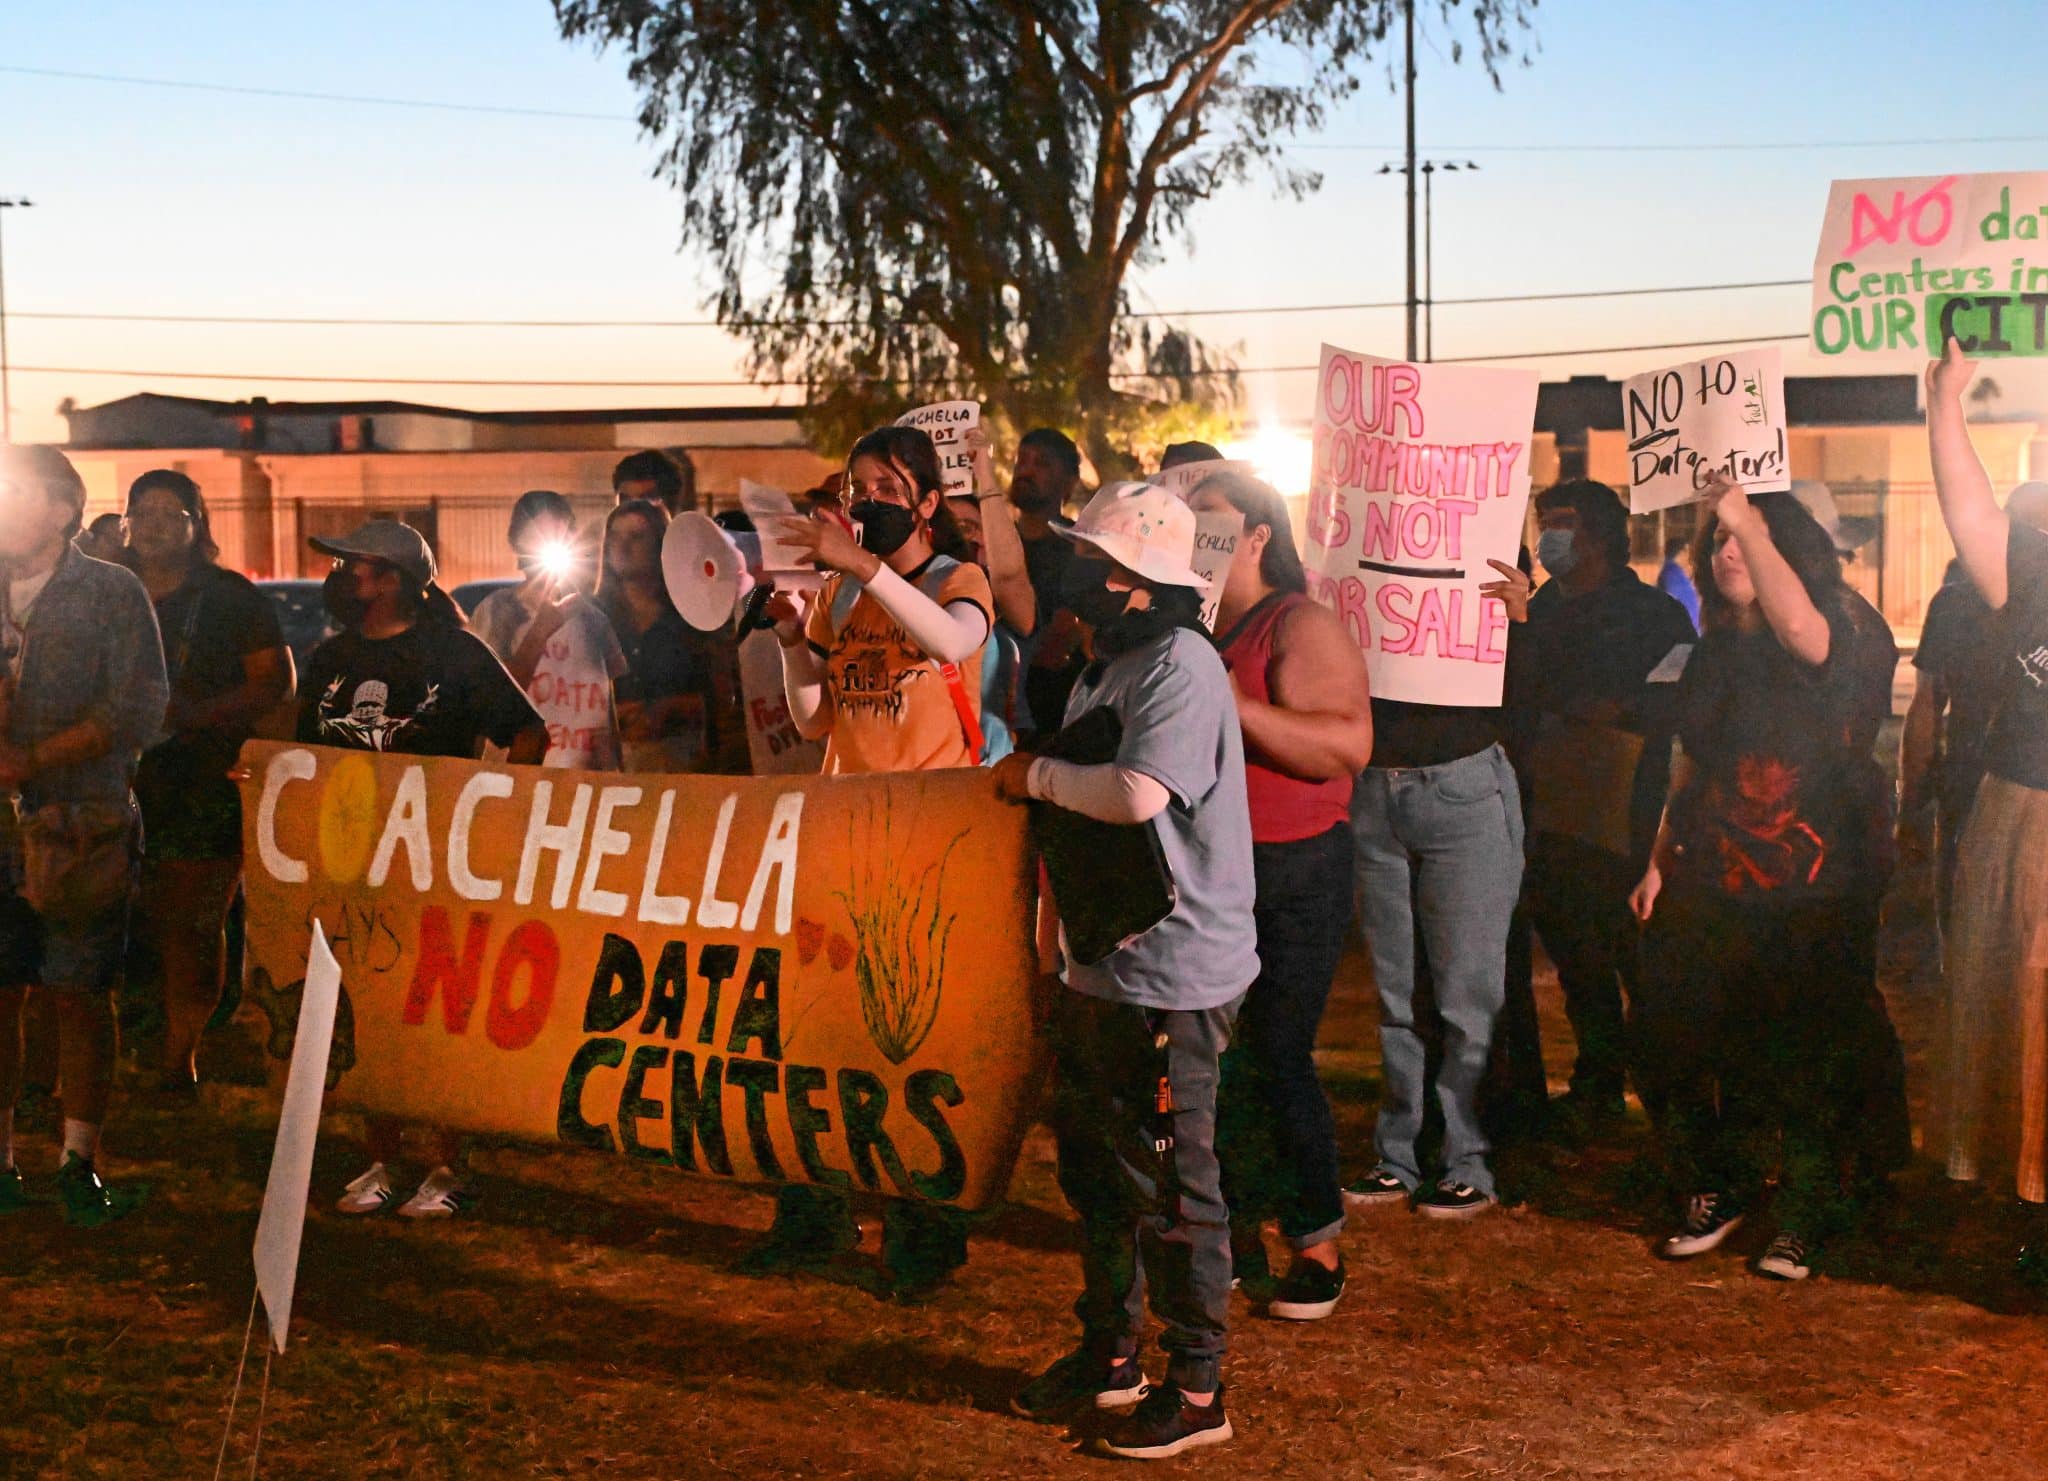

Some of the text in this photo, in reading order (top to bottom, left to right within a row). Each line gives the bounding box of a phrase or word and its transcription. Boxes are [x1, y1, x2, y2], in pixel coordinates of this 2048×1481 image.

[1841, 175, 1959, 257] NO
[1829, 257, 1994, 303] Centers
[1814, 298, 1919, 355] OUR
[1324, 354, 1424, 437] OUR
[1629, 371, 1683, 439] NO
[1313, 424, 1522, 500] COMMUNITY
[1631, 438, 1698, 487] Data
[1308, 487, 1478, 561] IS NOT
[1376, 583, 1506, 664] SALE
[256, 748, 805, 936] COACHELLA
[402, 905, 561, 1052] NO
[582, 932, 784, 1062] DATA
[557, 1036, 968, 1201] CENTERS
